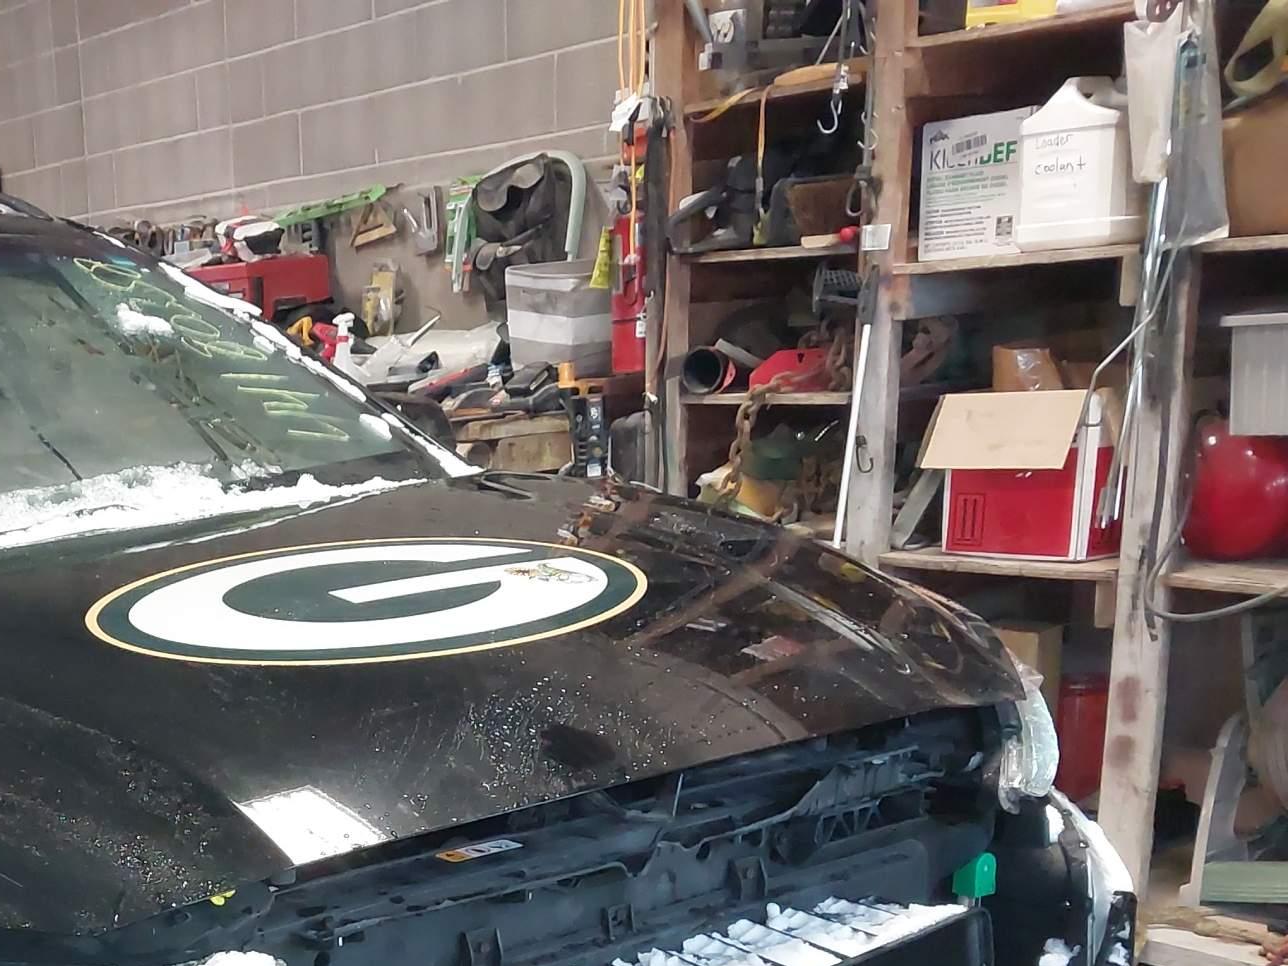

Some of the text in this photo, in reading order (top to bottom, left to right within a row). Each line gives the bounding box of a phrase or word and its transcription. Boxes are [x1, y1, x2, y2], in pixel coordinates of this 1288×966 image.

[1035, 133, 1074, 150] Loader
[1034, 154, 1087, 175] coolant
[128, 543, 608, 651] G
